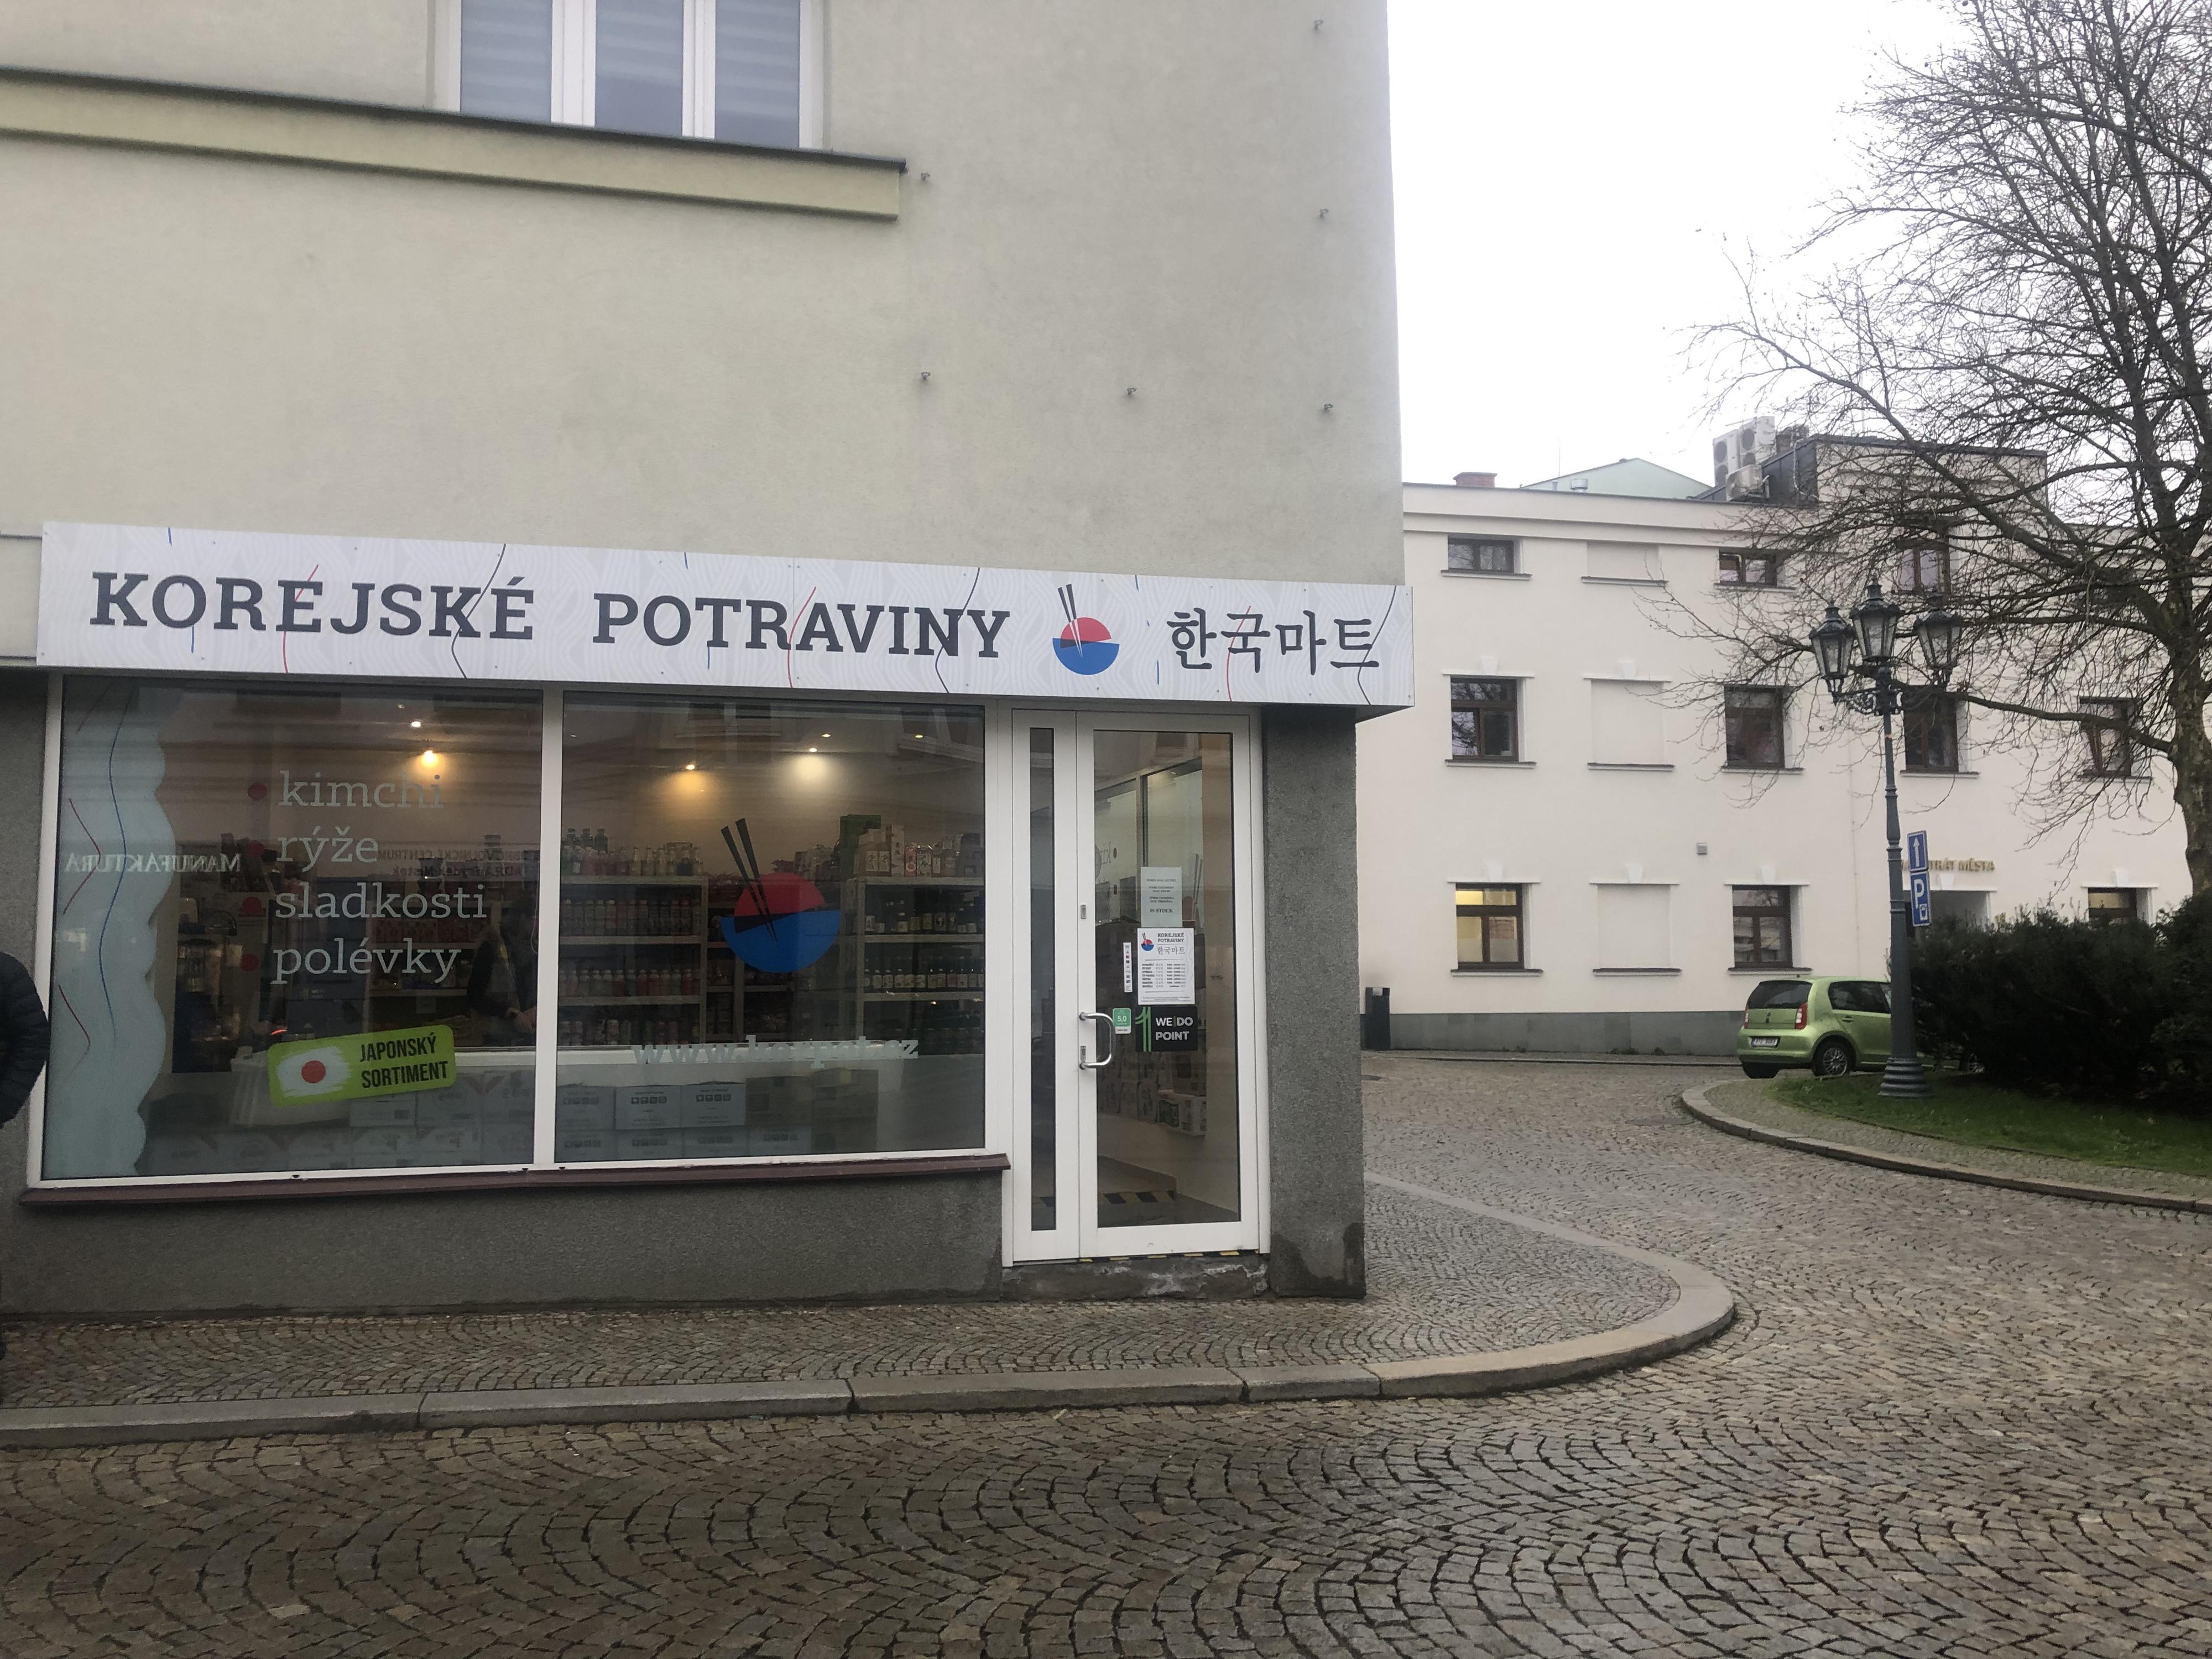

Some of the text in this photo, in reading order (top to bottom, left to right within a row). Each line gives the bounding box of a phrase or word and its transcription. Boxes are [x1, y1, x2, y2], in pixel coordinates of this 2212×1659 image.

[90, 571, 1010, 658] KOREJSKÉ POTRAVINY
[1167, 607, 1380, 675] 한국마트
[278, 770, 444, 808] kimchi
[276, 826, 379, 872] rýže
[275, 882, 487, 919] sladkosti
[1914, 879, 1924, 909] P
[270, 937, 462, 984] polévky
[1157, 946, 1186, 954] 한국마트
[360, 1032, 437, 1062] JAPONSKÝ
[1155, 1031, 1190, 1041] POINT
[361, 1061, 448, 1088] SORTIMENT
